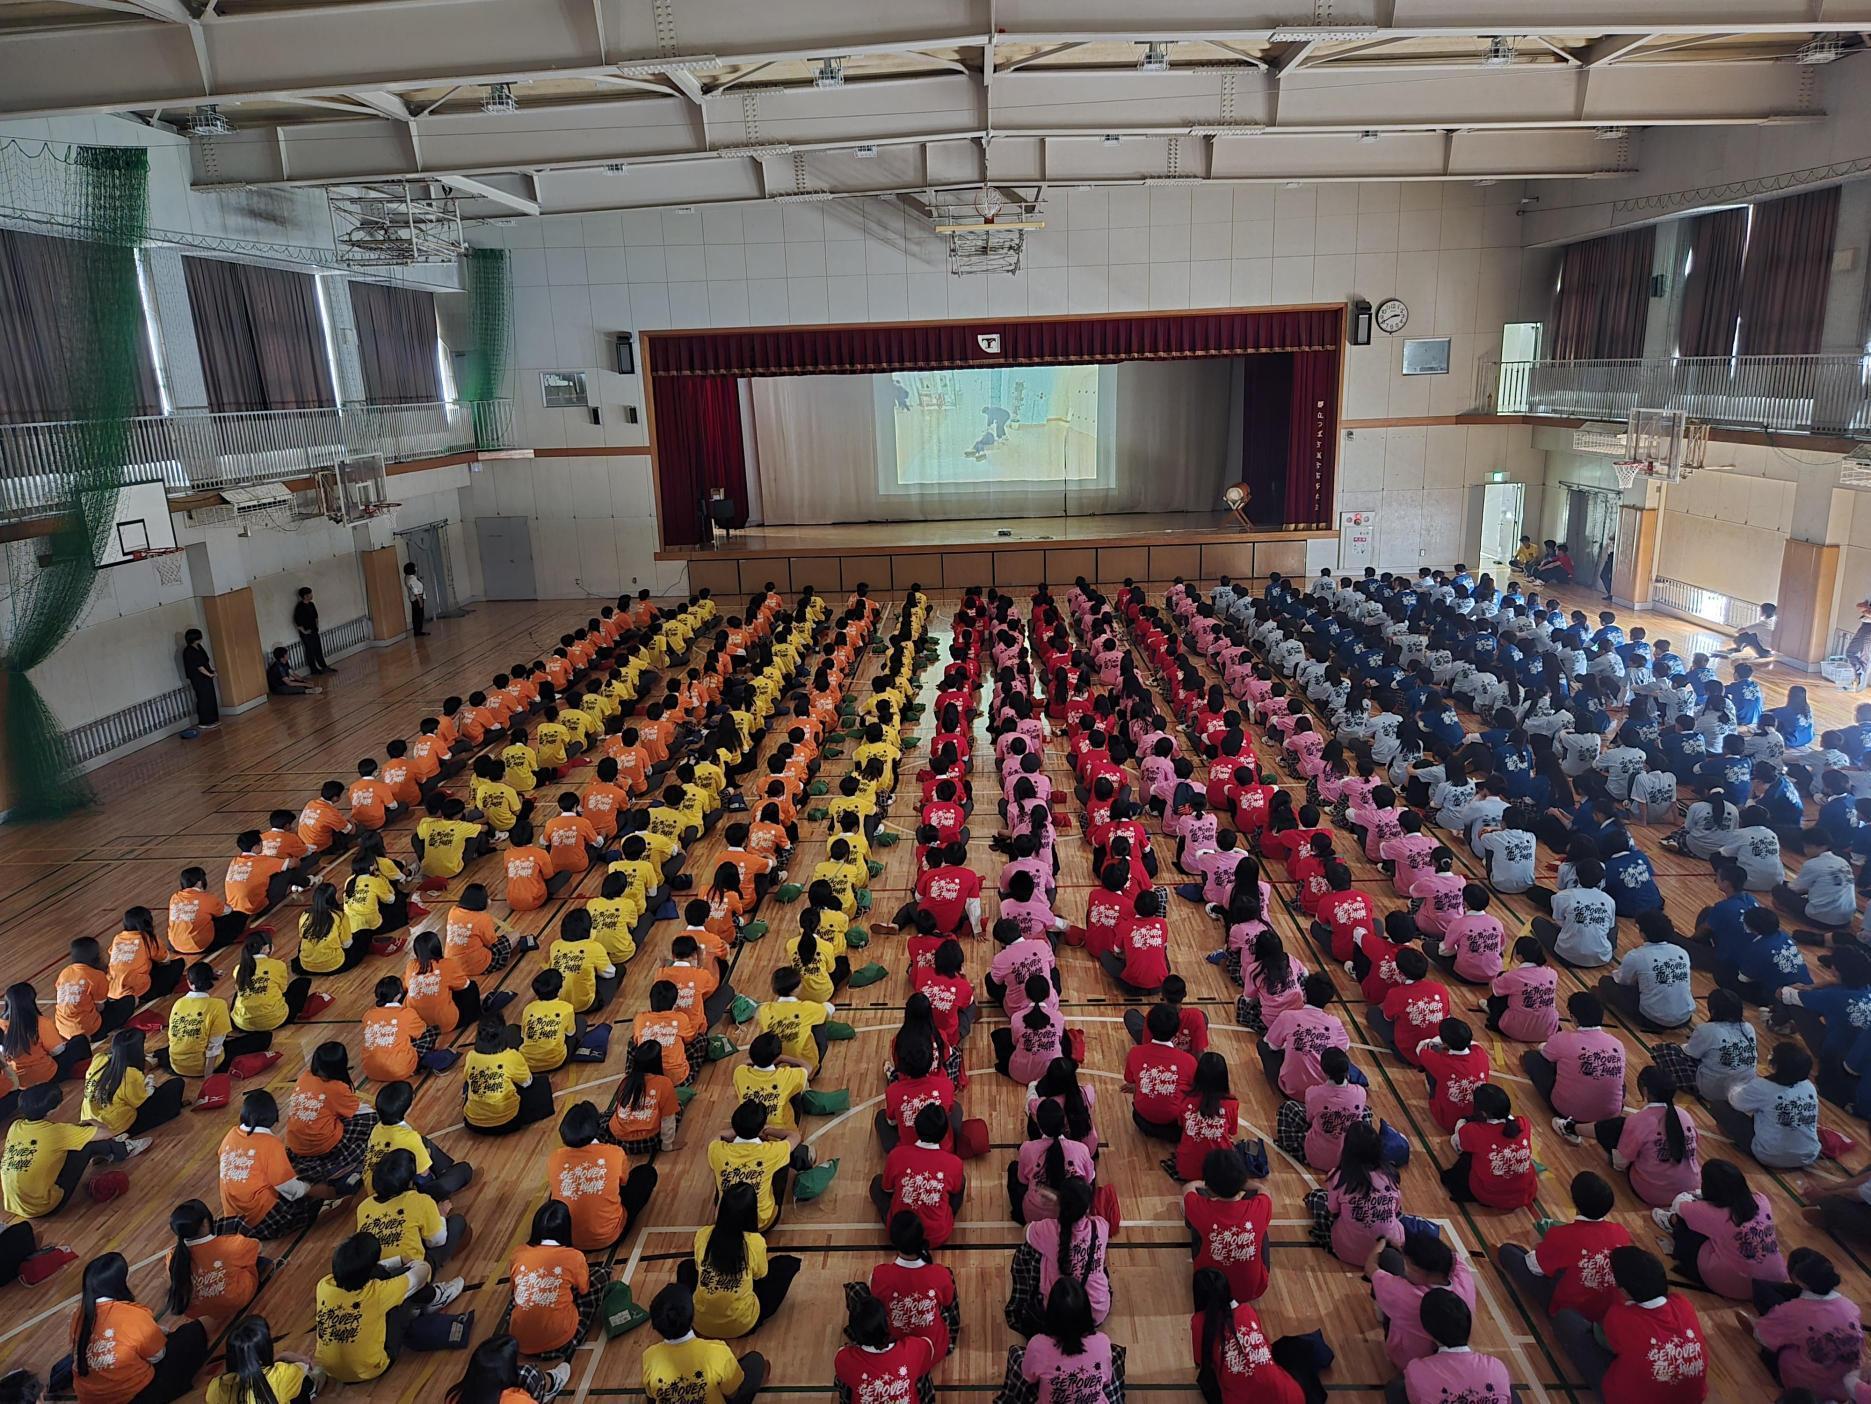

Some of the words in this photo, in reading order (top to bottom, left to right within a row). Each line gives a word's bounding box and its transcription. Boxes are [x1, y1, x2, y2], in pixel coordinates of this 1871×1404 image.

[1599, 1054, 1623, 1063] OVER
[1155, 1071, 1177, 1080] OVER
[1509, 1147, 1532, 1159] OVER
[920, 1179, 944, 1189] OVER
[1370, 1194, 1394, 1205] OVER
[1230, 1232, 1256, 1244] OVER
[910, 1298, 937, 1310] OVER
[1673, 1340, 1703, 1358] OVER
[882, 1378, 911, 1395] OVER
[1074, 1374, 1103, 1388] OVER
[678, 1380, 706, 1395] OVER
